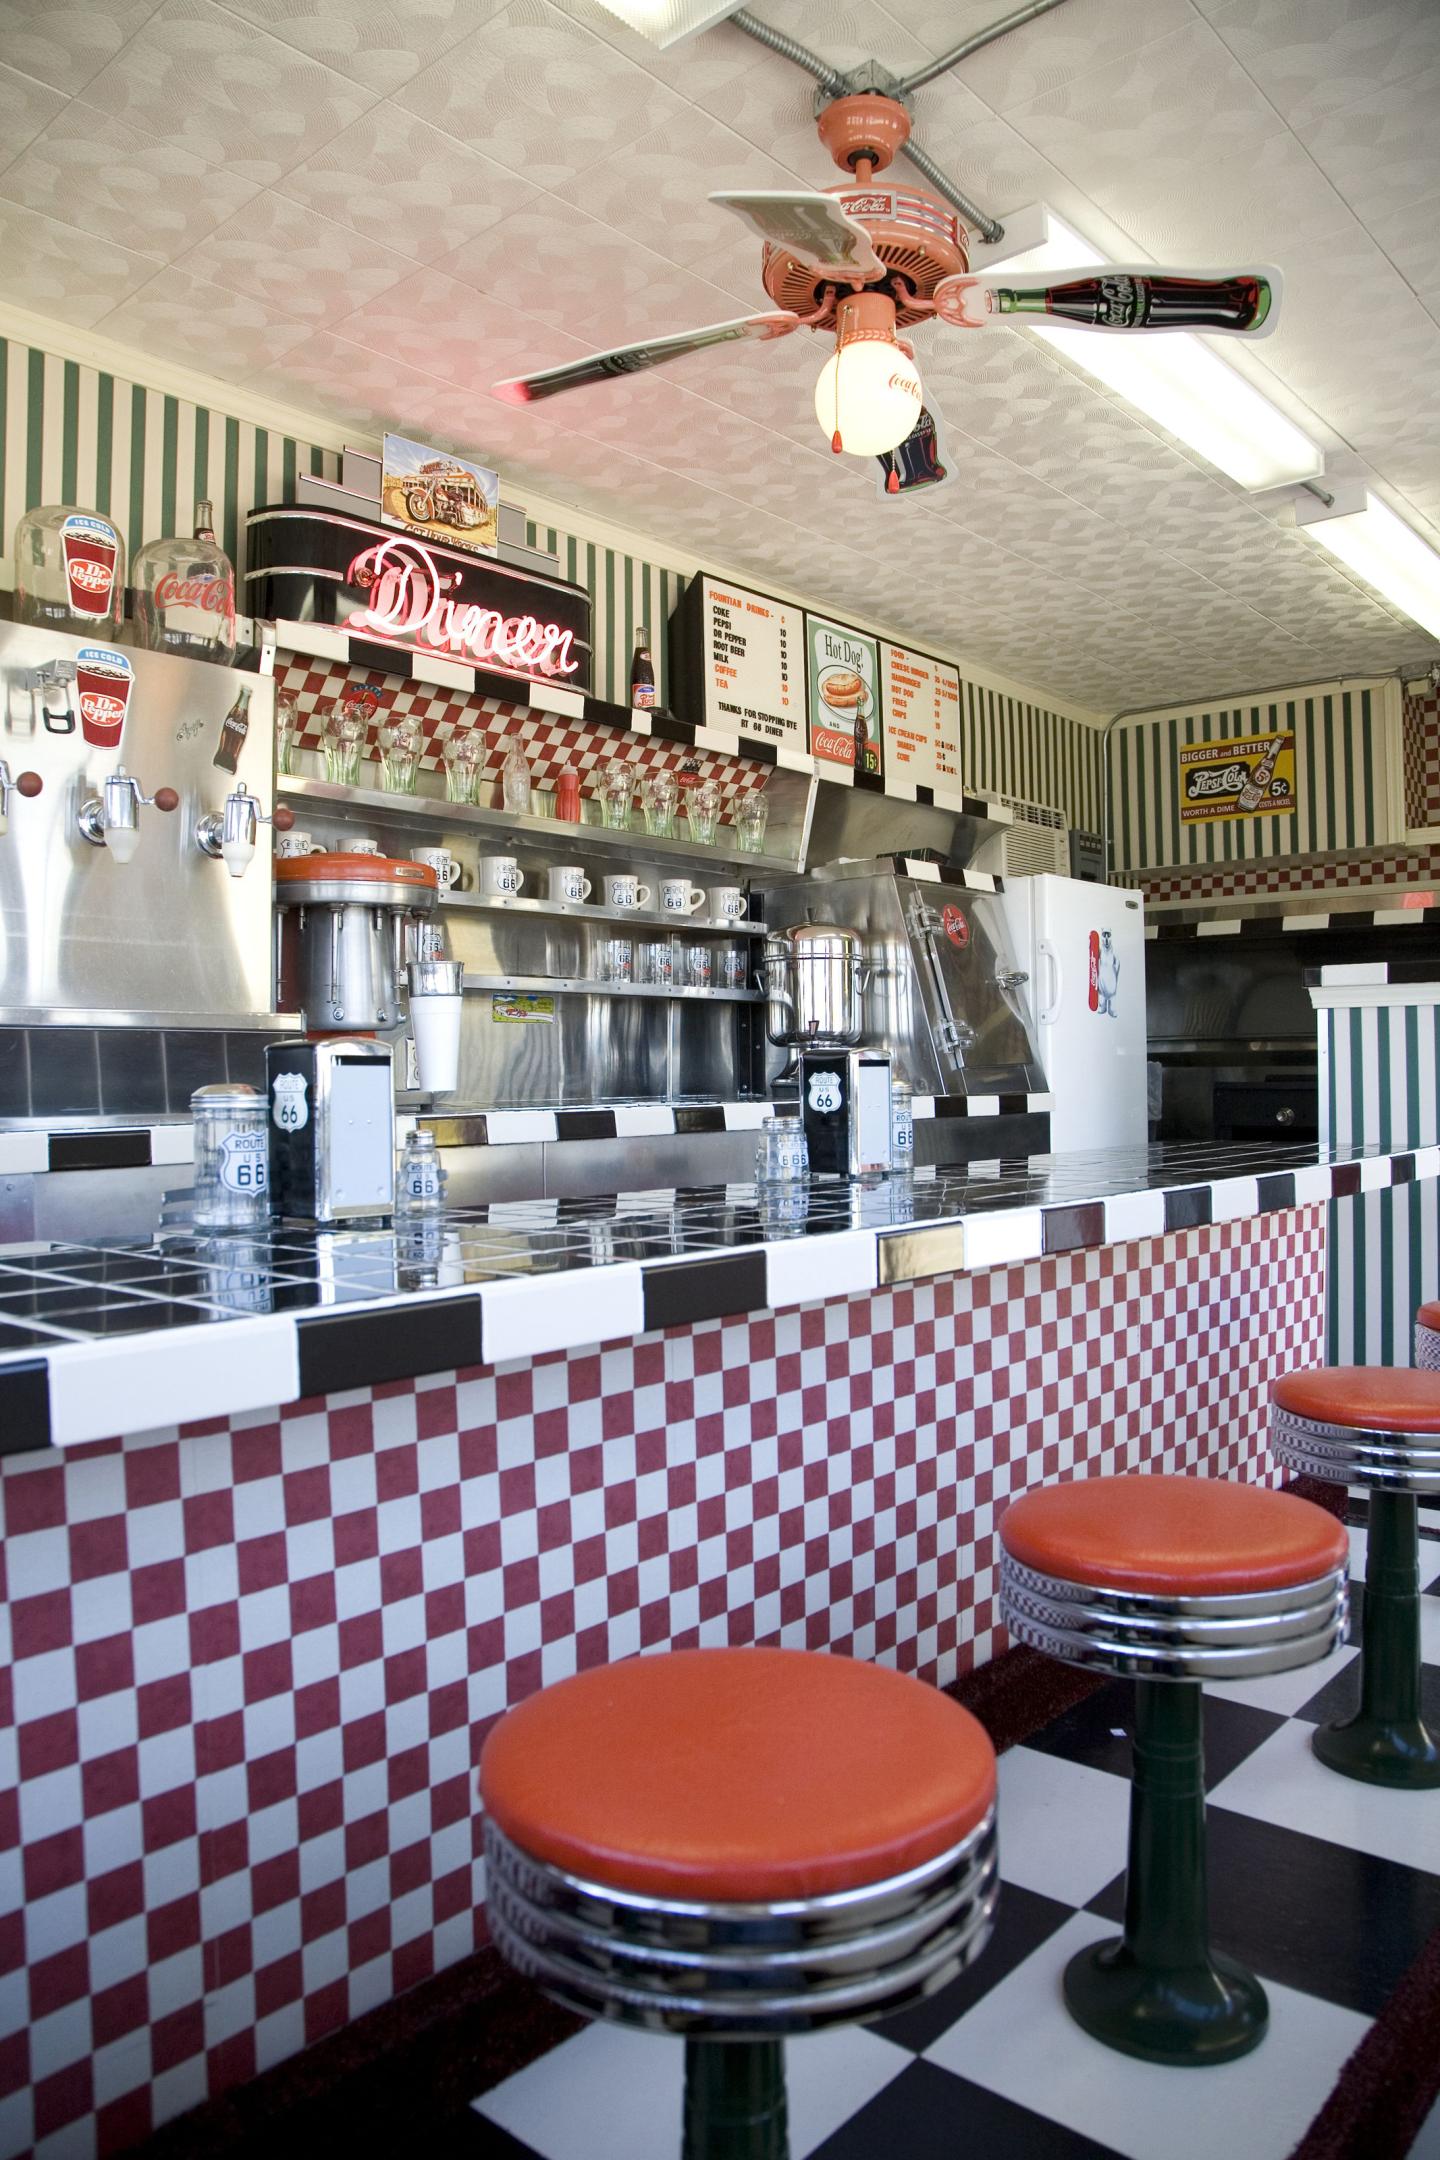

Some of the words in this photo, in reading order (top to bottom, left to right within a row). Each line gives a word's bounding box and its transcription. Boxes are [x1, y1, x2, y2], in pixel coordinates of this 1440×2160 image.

[75, 519, 89, 527] ICE
[91, 520, 111, 534] COLD
[72, 565, 112, 587] Pepper
[86, 563, 106, 578] Dr
[347, 537, 579, 676] Diner
[713, 605, 730, 618] COKE
[780, 629, 786, 637] 10
[713, 617, 731, 630] PEPSI
[780, 640, 786, 648] 10
[713, 629, 723, 639] DR
[724, 632, 747, 646] PEPPER
[781, 651, 787, 659] 10
[824, 634, 842, 660] Hot
[844, 641, 864, 673] Dog!
[85, 650, 99, 659] ICE
[100, 652, 123, 665] COLD
[713, 640, 729, 652] ROOT
[730, 645, 745, 657] BEER
[781, 662, 787, 670] 10
[713, 652, 729, 664] MILK
[782, 673, 788, 681] 10
[714, 664, 737, 678] COFFEE
[782, 684, 788, 693] 10
[715, 678, 729, 689] TEA
[782, 697, 789, 705] 10
[84, 699, 124, 722] Pepper
[95, 696, 117, 711] Dr
[718, 702, 742, 715] THANKS
[744, 708, 757, 719] FOR
[758, 712, 785, 727] STOPPING
[786, 720, 798, 730] BYE
[741, 719, 749, 728] RT
[753, 723, 761, 731] 66
[765, 725, 783, 737] DINER
[815, 731, 855, 759] Coca-Cola
[1181, 749, 1219, 763] BIGGER
[1220, 750, 1232, 758] and
[1233, 741, 1271, 756] BETTER
[1271, 781, 1288, 797] 5¢
[1183, 808, 1209, 817] WORTH
[1216, 804, 1236, 813] DIME
[503, 878, 516, 889] 66
[280, 1080, 300, 1090] ROUTE
[816, 1094, 833, 1108] 66
[281, 1105, 298, 1124] 66
[235, 1138, 265, 1150] ROUTE
[411, 1164, 433, 1172] ROUTE
[792, 1154, 807, 1165] 66
[237, 1164, 264, 1185] 66
[413, 1180, 434, 1194] 66
